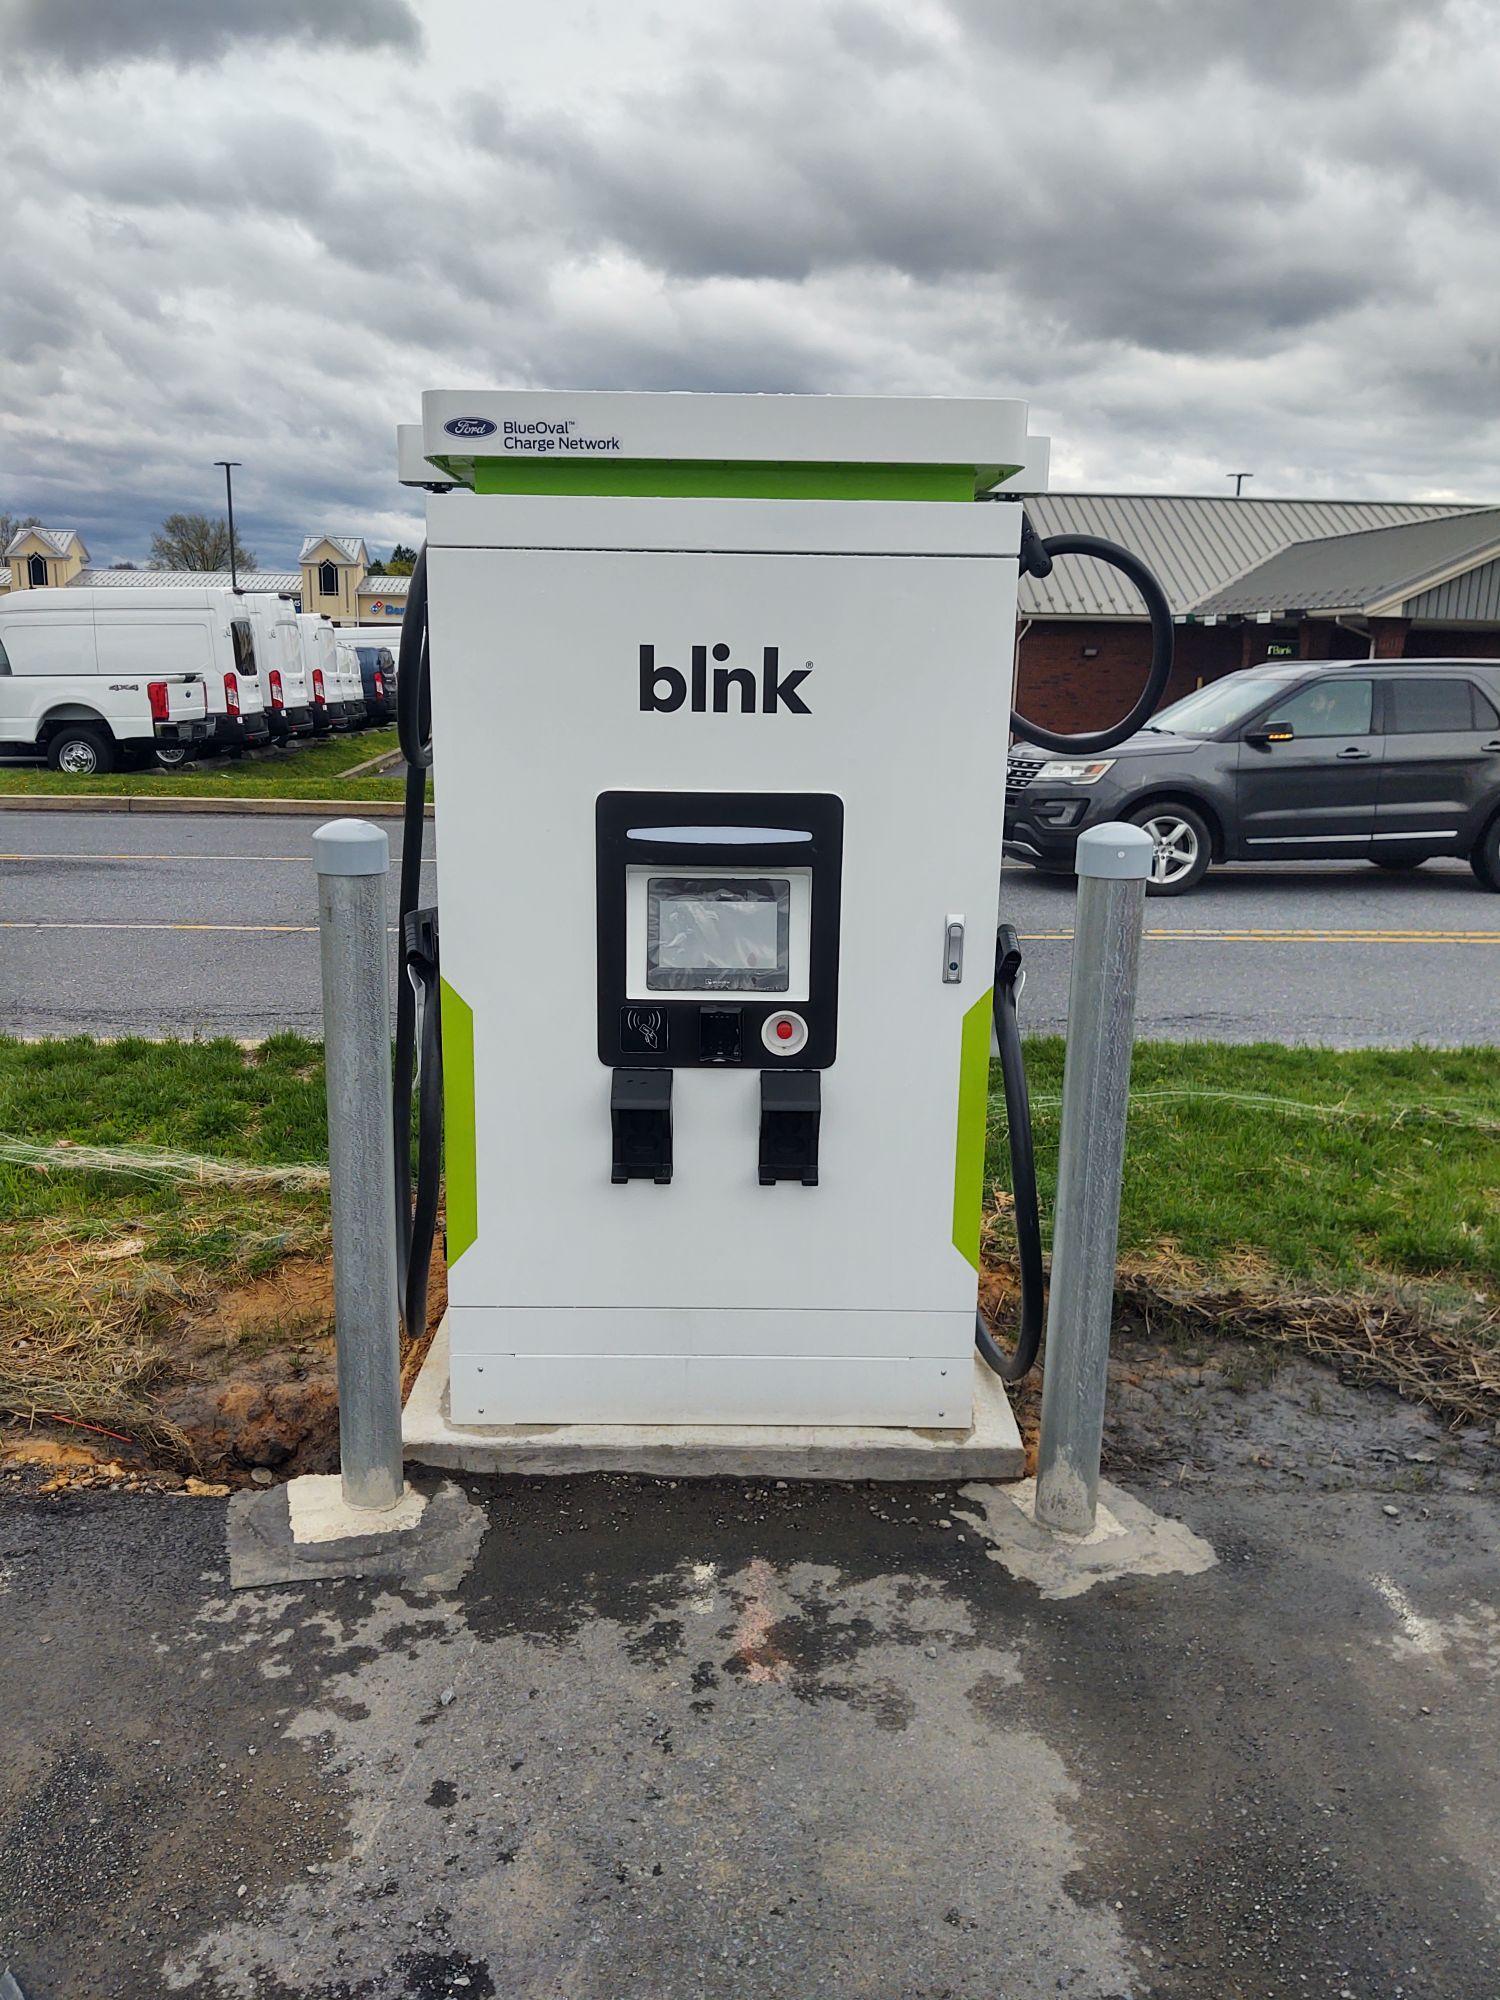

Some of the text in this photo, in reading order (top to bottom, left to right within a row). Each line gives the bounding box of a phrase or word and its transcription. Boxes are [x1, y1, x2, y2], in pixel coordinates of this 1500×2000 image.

[454, 420, 486, 434] Ford
[503, 437, 620, 451] Charge Network
